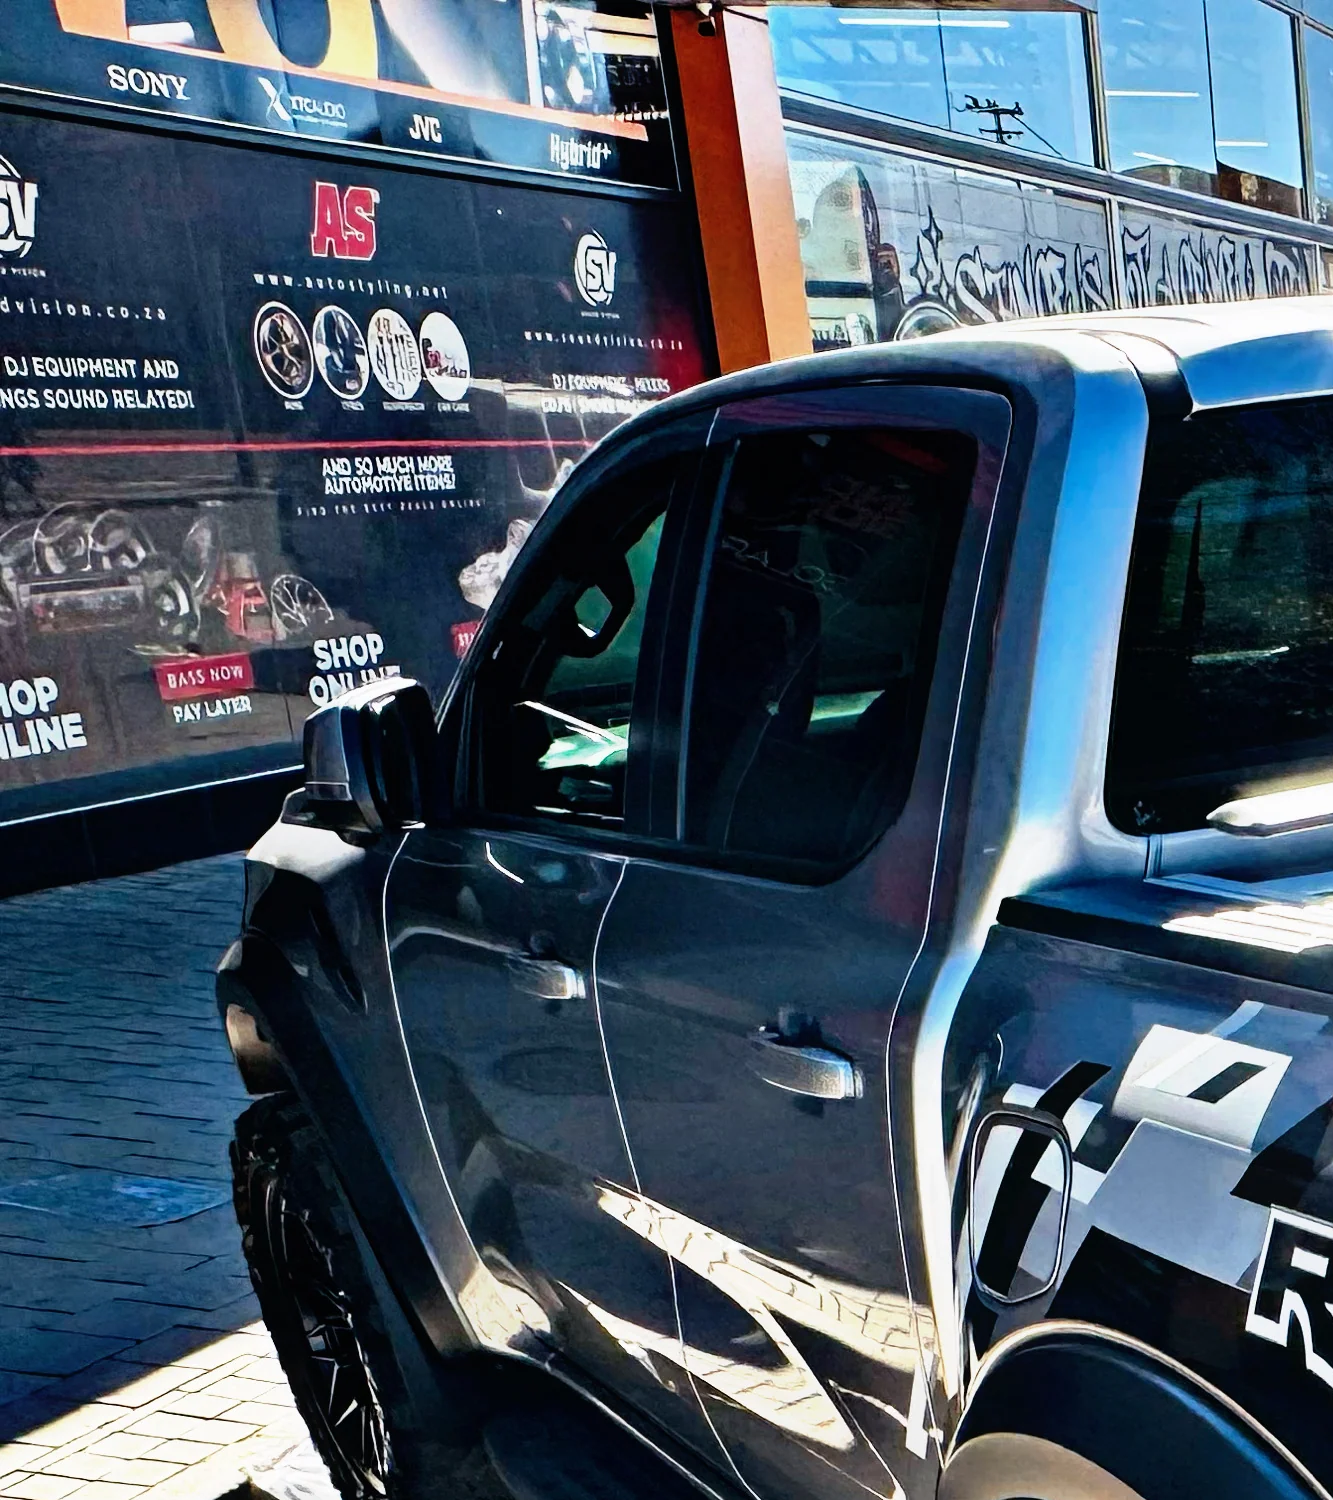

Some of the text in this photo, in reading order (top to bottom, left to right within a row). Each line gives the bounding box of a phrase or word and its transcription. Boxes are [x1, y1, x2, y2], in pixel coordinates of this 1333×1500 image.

[106, 64, 190, 100] SONY
[408, 114, 442, 143] JVC
[551, 133, 611, 170] Hybrid+
[310, 181, 380, 261] AS
[4, 355, 180, 379] DJ EQUIPMENT AND
[43, 388, 109, 409] SOUND
[112, 389, 195, 409] RELATED!
[322, 455, 454, 476] AND SO MUCH MORE
[324, 473, 413, 495] AUTOMOTIVE
[313, 634, 384, 671] SHOP
[210, 665, 244, 682] NOW
[172, 696, 252, 724] PAY LATER
